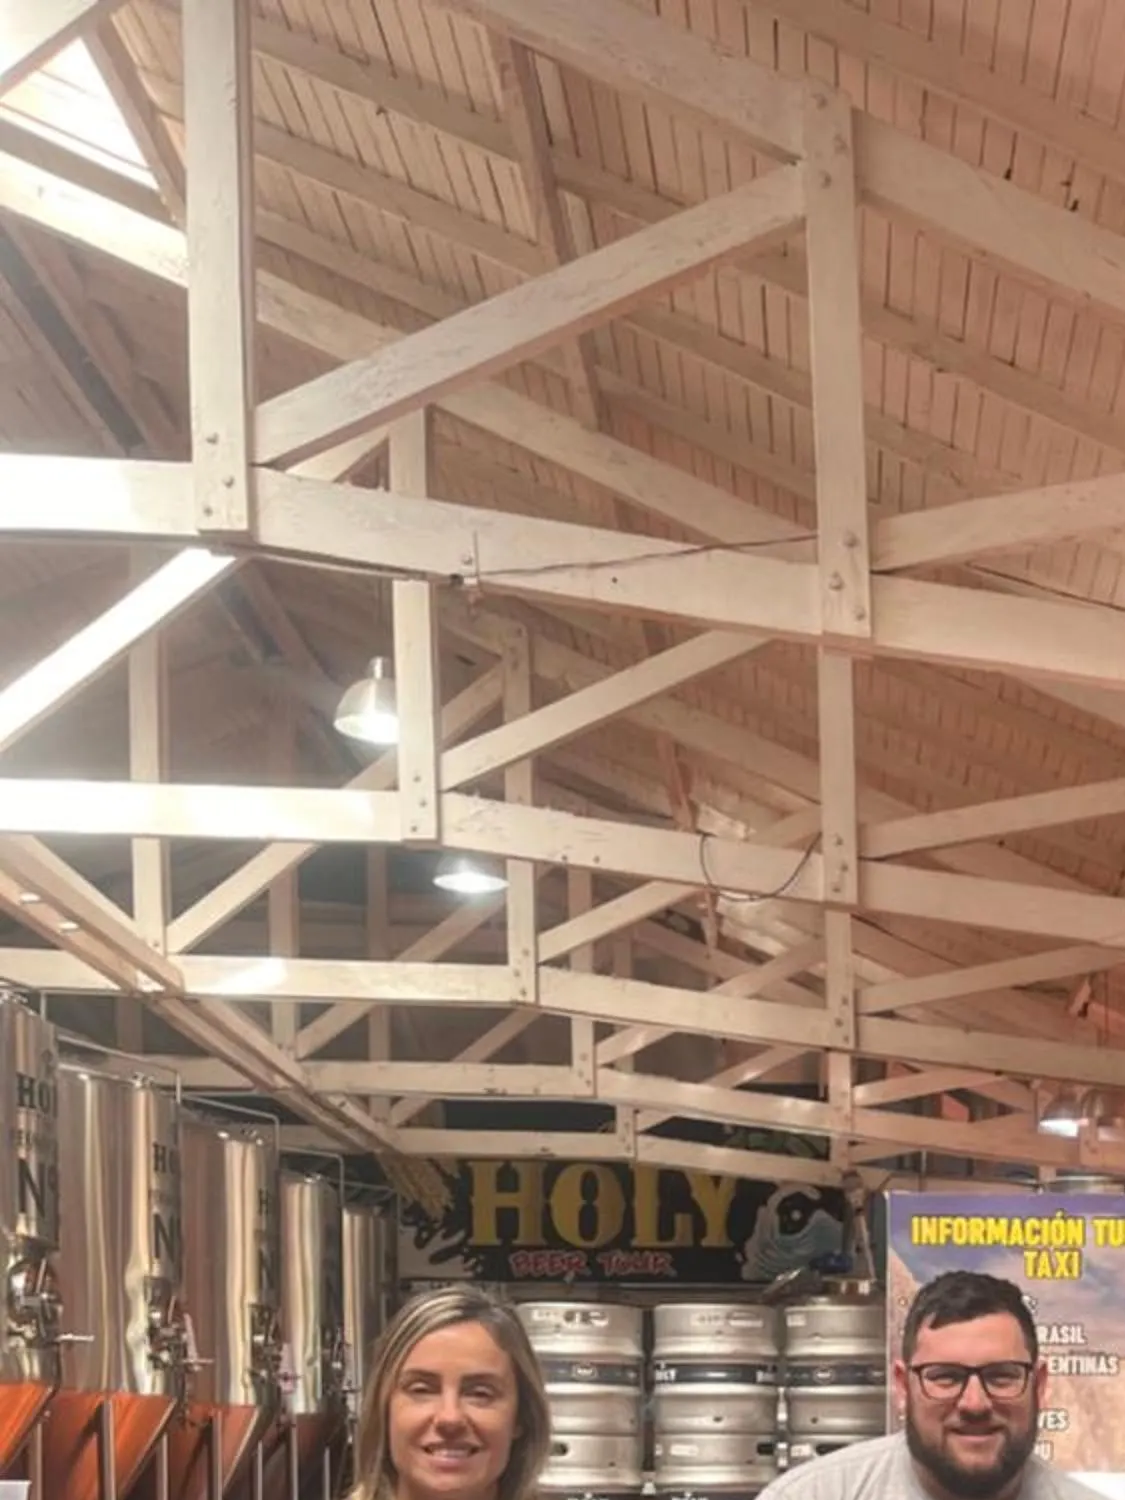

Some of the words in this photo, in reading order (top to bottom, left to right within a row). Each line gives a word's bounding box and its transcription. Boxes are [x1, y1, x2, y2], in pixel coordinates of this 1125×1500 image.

[467, 1160, 738, 1248] HOLY
[911, 1211, 1086, 1247] INFORMACIÓN
[1023, 1250, 1083, 1278] TAXI
[1037, 1324, 1087, 1345] RASIL
[1040, 1355, 1120, 1377] ENTINAS
